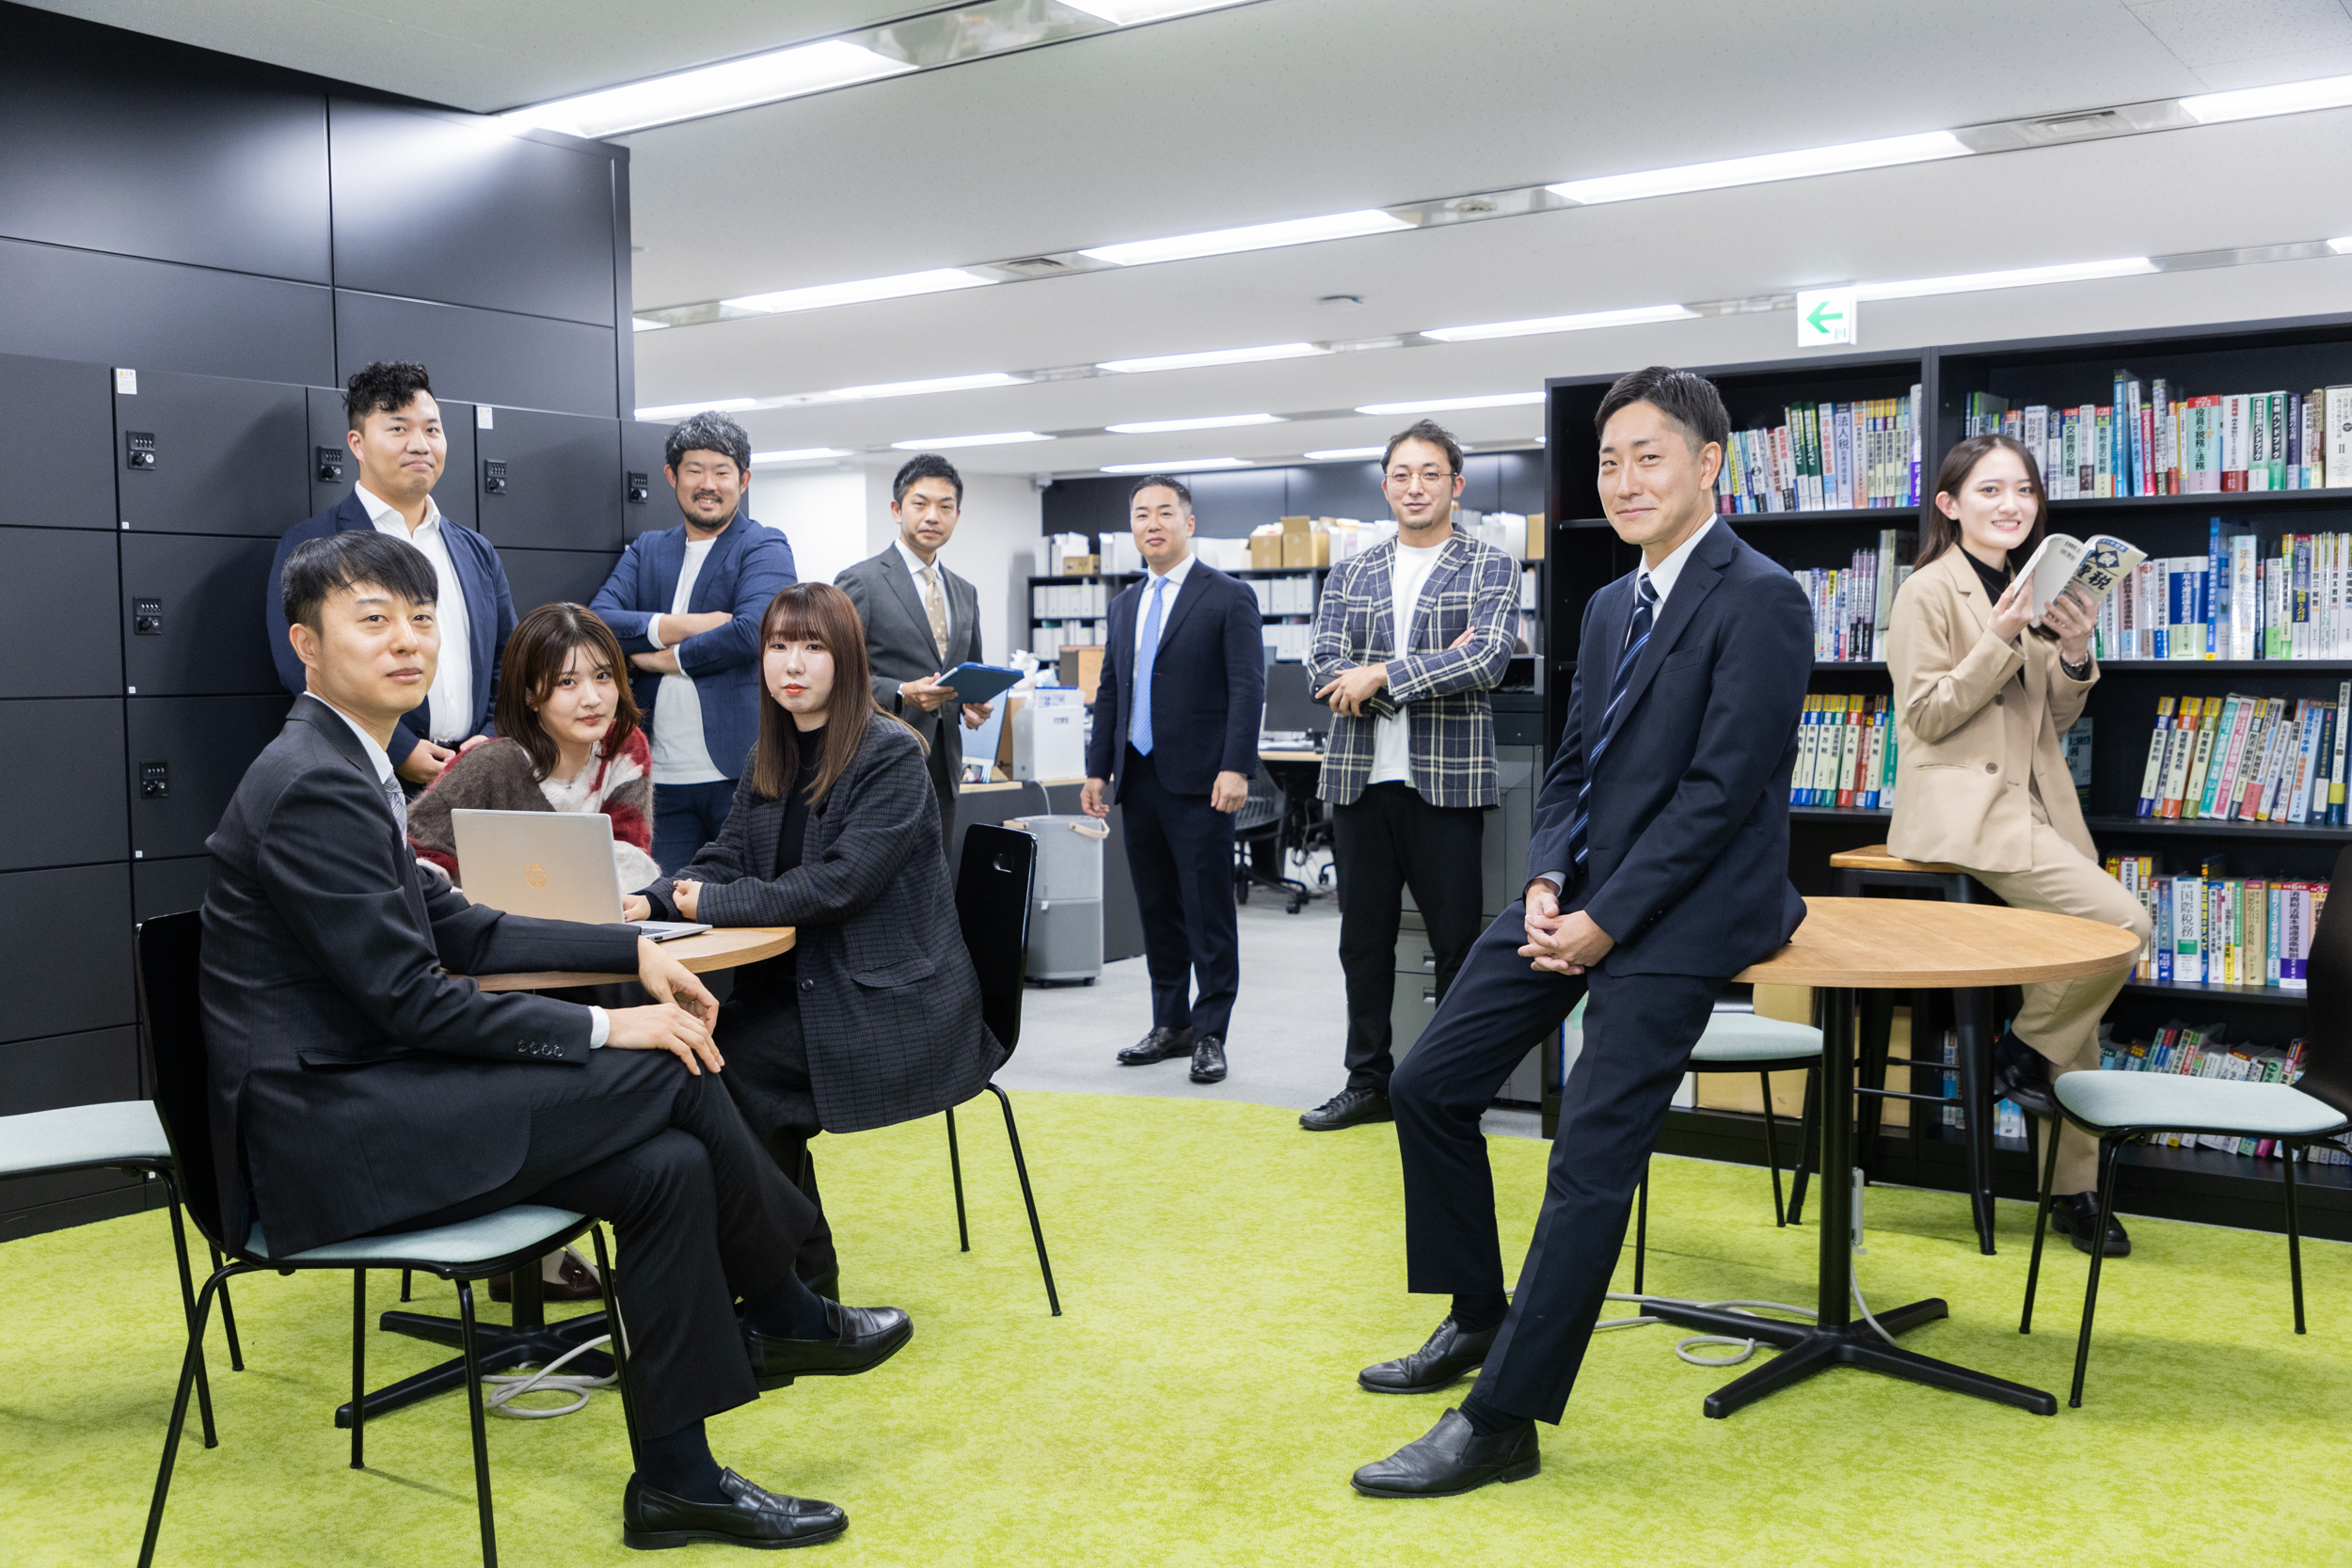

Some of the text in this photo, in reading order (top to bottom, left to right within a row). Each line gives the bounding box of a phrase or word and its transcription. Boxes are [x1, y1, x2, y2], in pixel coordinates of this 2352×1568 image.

[1837, 415, 1850, 450] 法人税
[2066, 425, 2075, 477] 交際費の税務
[2098, 427, 2107, 474] 寄附金の税務
[2195, 408, 2205, 471] 役員の税務と法務
[2273, 396, 2281, 460] 合併ハンドブック
[2181, 890, 2193, 938] 国際税務
